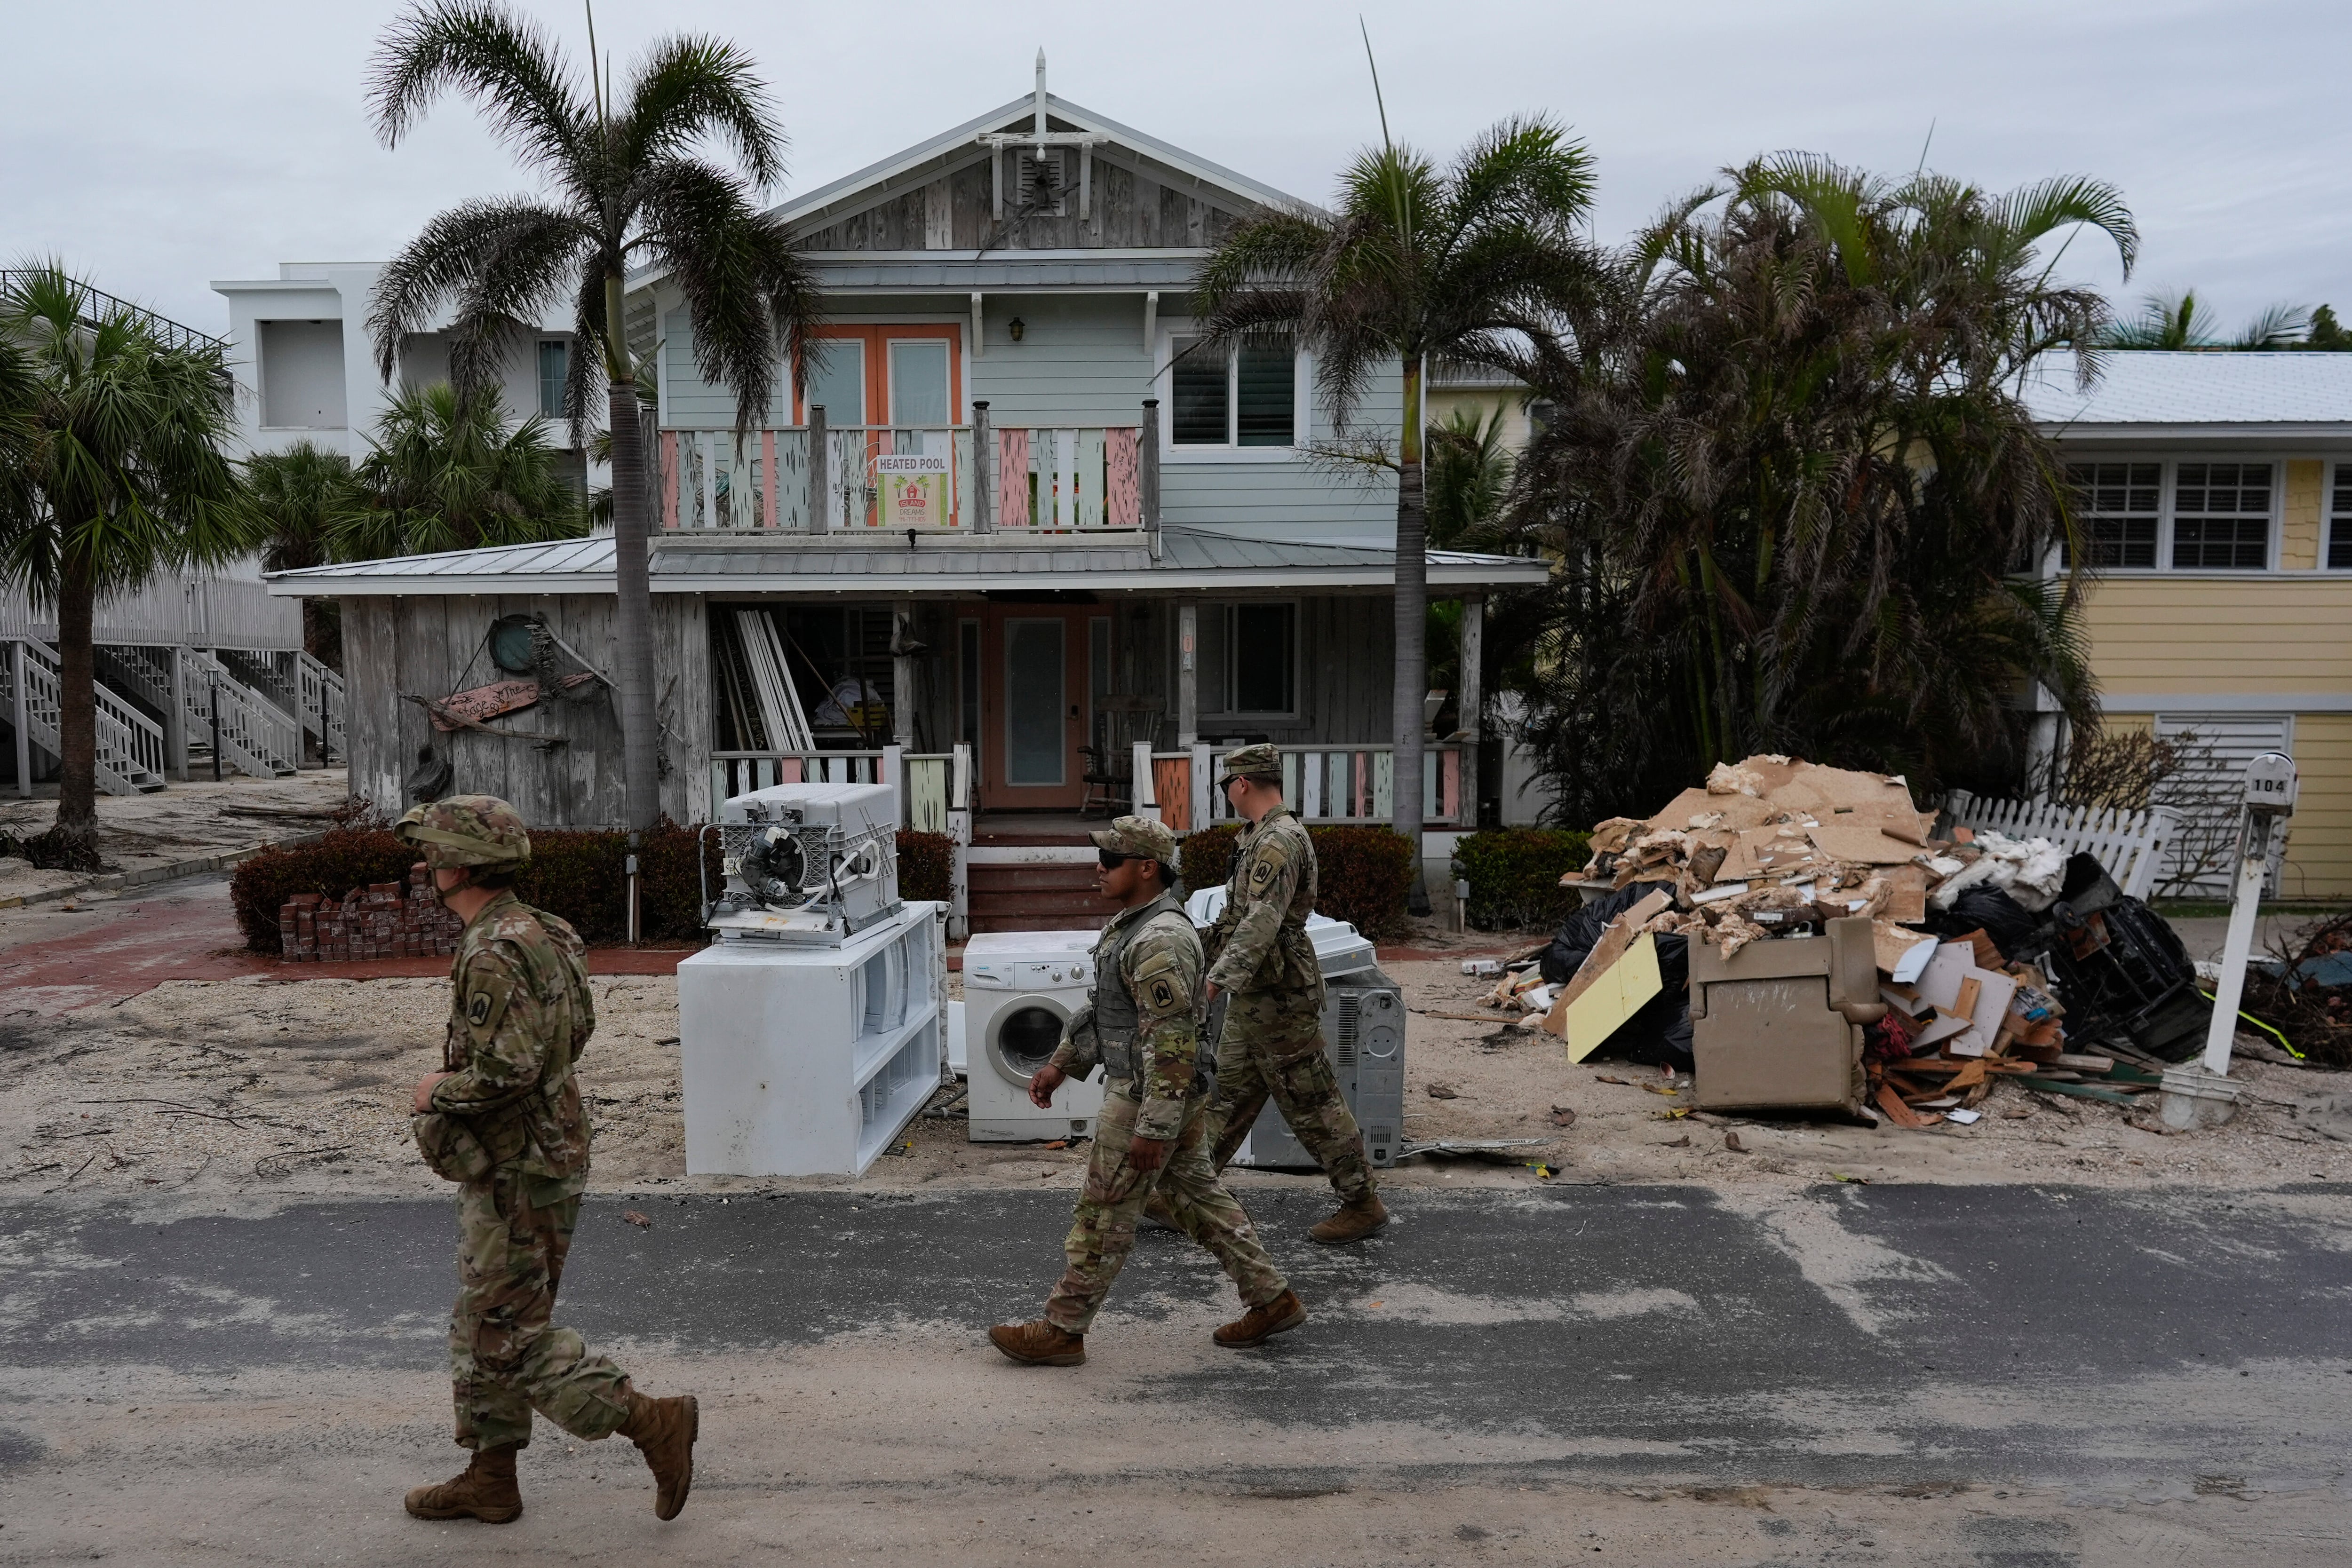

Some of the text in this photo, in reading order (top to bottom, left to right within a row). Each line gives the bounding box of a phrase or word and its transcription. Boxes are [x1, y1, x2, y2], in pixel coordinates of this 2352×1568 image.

[880, 458, 945, 469] HEATED POOL
[501, 685, 522, 700] The
[2255, 779, 2285, 792] 104
